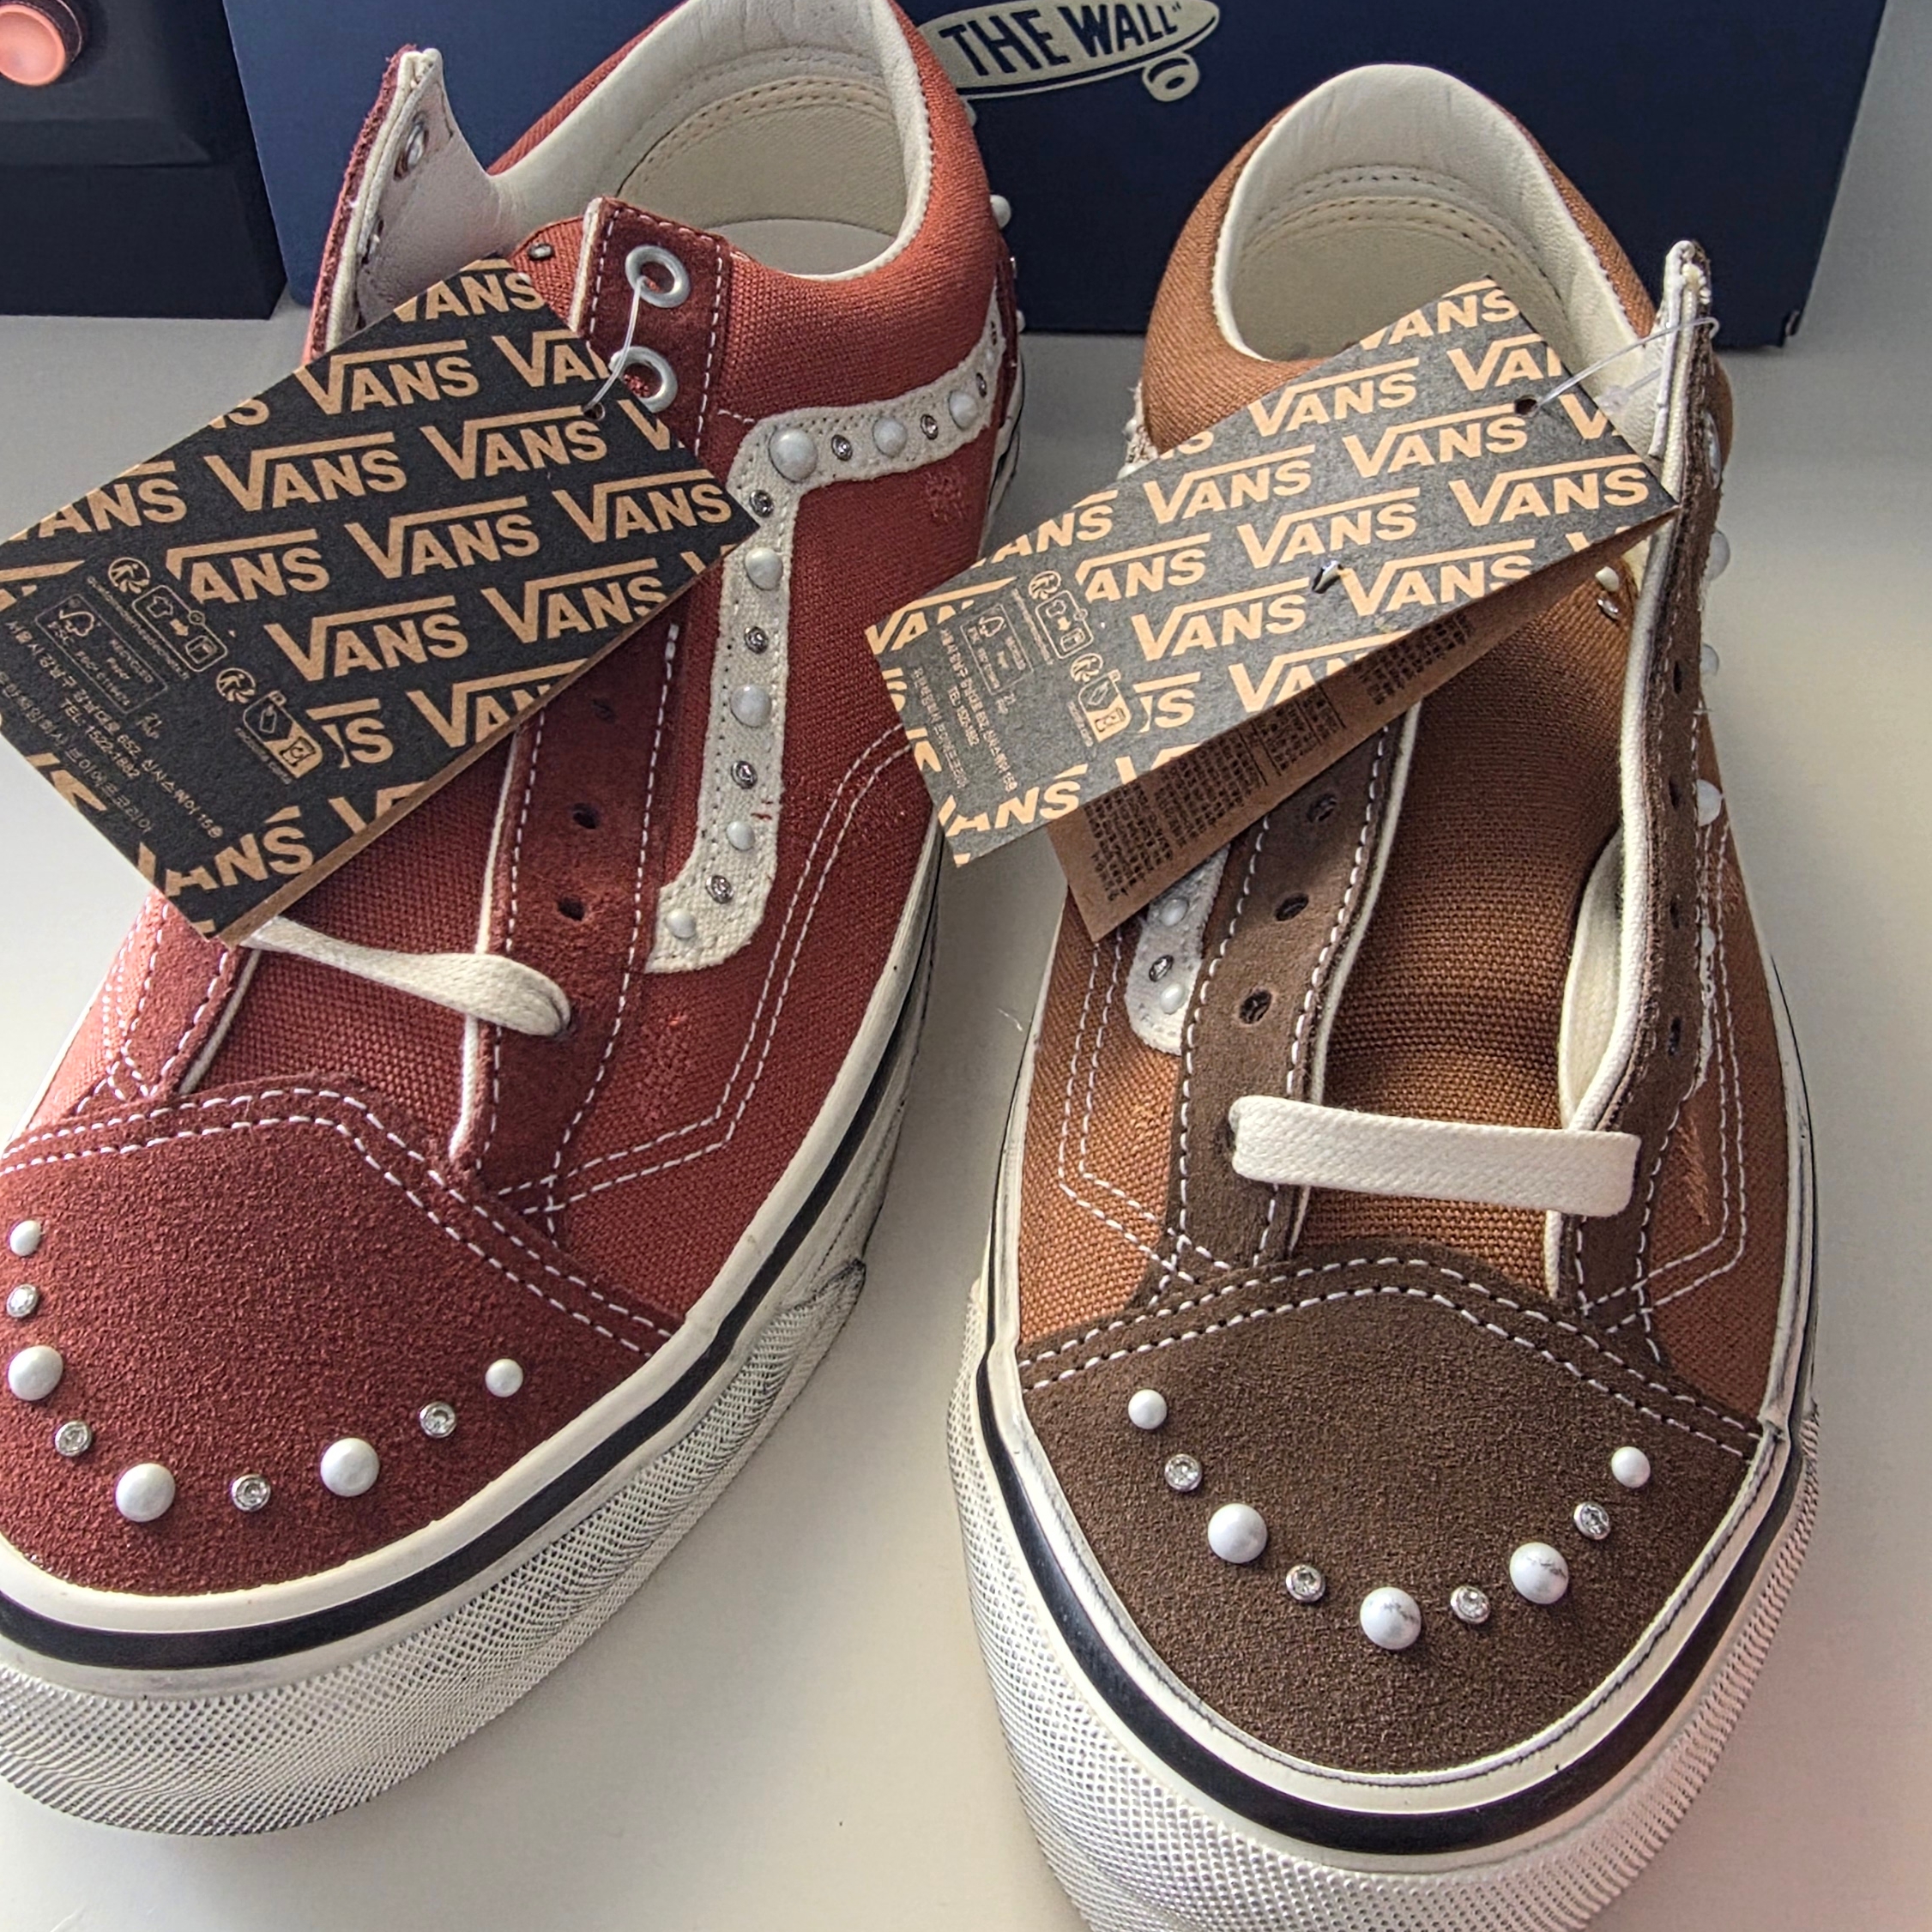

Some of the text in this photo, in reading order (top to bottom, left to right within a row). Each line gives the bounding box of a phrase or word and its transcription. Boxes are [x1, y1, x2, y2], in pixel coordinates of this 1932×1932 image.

[939, 10, 1071, 76] THE
[296, 341, 479, 414] VANS
[1249, 357, 1421, 438] VANS
[9, 461, 186, 538] ANS
[205, 432, 406, 510] VANS
[422, 406, 607, 479] VANS
[970, 490, 1119, 569] ANS
[1143, 443, 1315, 525] VANS
[1342, 403, 1528, 478] VANS
[1236, 486, 1420, 570] VANS
[1448, 455, 1648, 527] VANS
[347, 497, 539, 578] VANS
[553, 469, 731, 542] VANS
[266, 558, 666, 680] VANS VANS
[1130, 577, 1310, 662] VANS
[1338, 538, 1536, 618] VANS
[108, 639, 154, 684] RECYCLED
[408, 660, 588, 747] VA
[1229, 630, 1411, 712] VA
[59, 698, 87, 726] TEL:
[83, 724, 140, 781] 1522-1882
